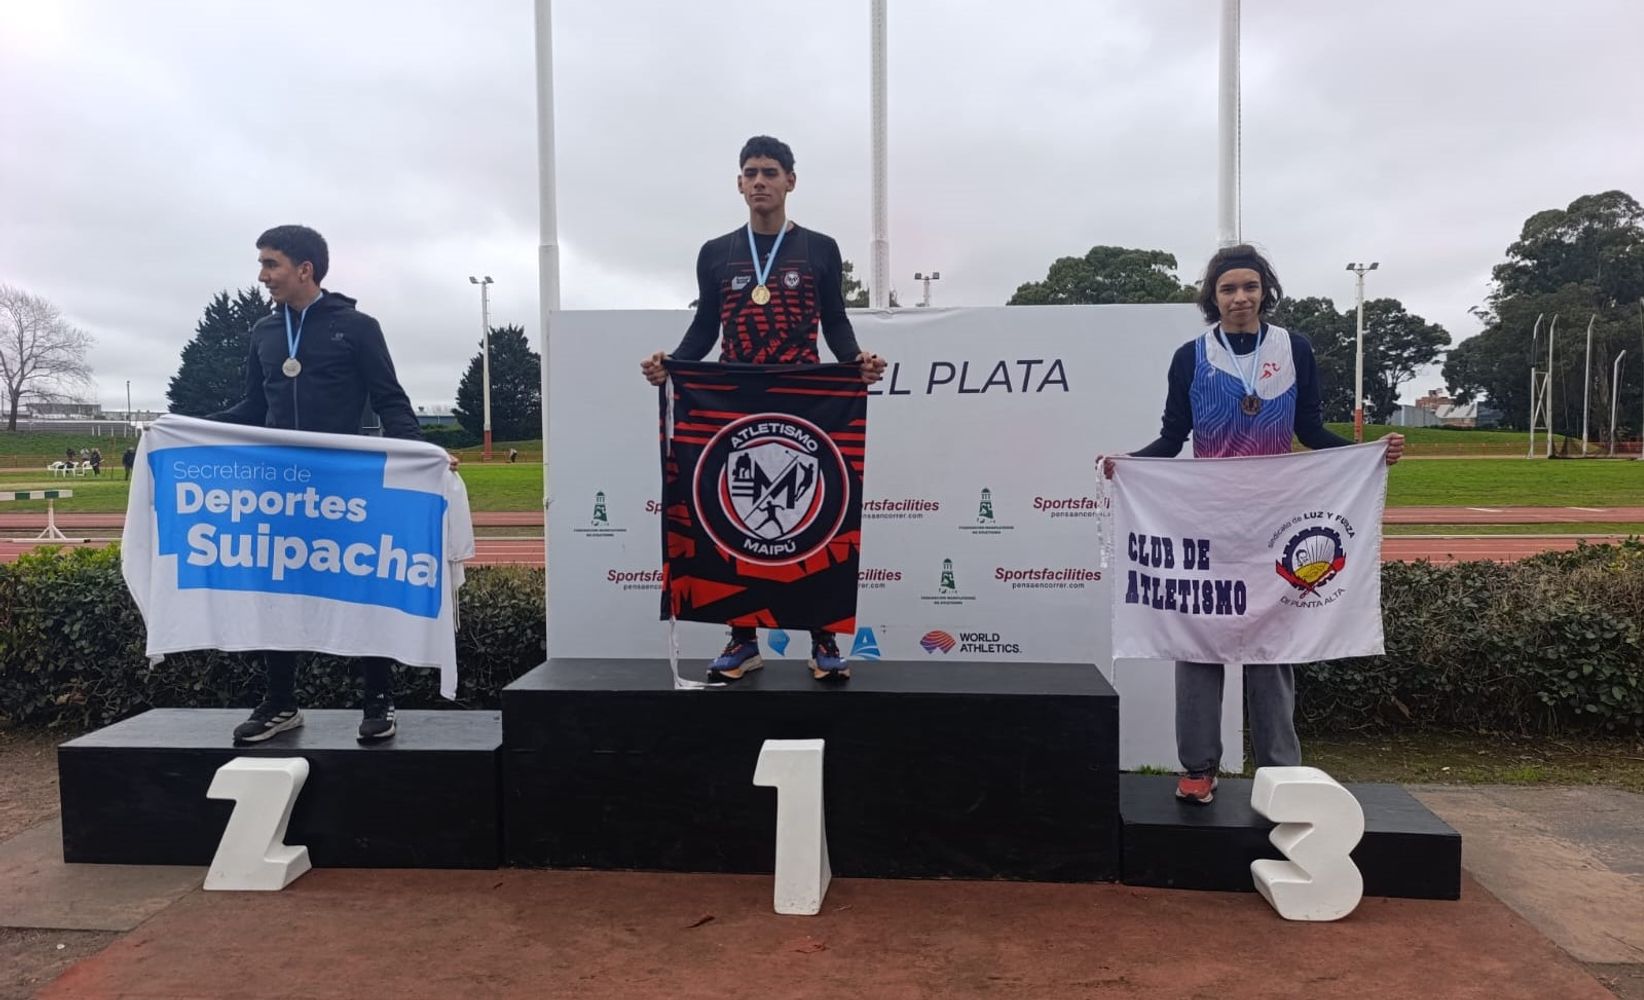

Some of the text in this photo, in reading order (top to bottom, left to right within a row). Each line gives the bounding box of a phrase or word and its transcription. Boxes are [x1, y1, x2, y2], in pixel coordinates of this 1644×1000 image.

[926, 359, 1069, 395] PLATA
[730, 422, 819, 453] ATLETISMO
[173, 461, 312, 483] Secretaria de
[176, 482, 367, 522] Deportes
[1304, 511, 1324, 520] LUZ
[187, 522, 438, 588] Suipacha
[743, 538, 796, 556] MAIPÚ
[1128, 531, 1210, 570] CLUB DE
[994, 567, 1102, 583] Sportsfacilities
[1125, 570, 1247, 616] ATLETISMO
[1290, 600, 1324, 608] PUNTA
[1324, 588, 1346, 605] ALTA
[960, 633, 1000, 642] WORLD
[203, 757, 312, 891] 2
[753, 739, 832, 916] 1
[1250, 766, 1365, 922] 3
